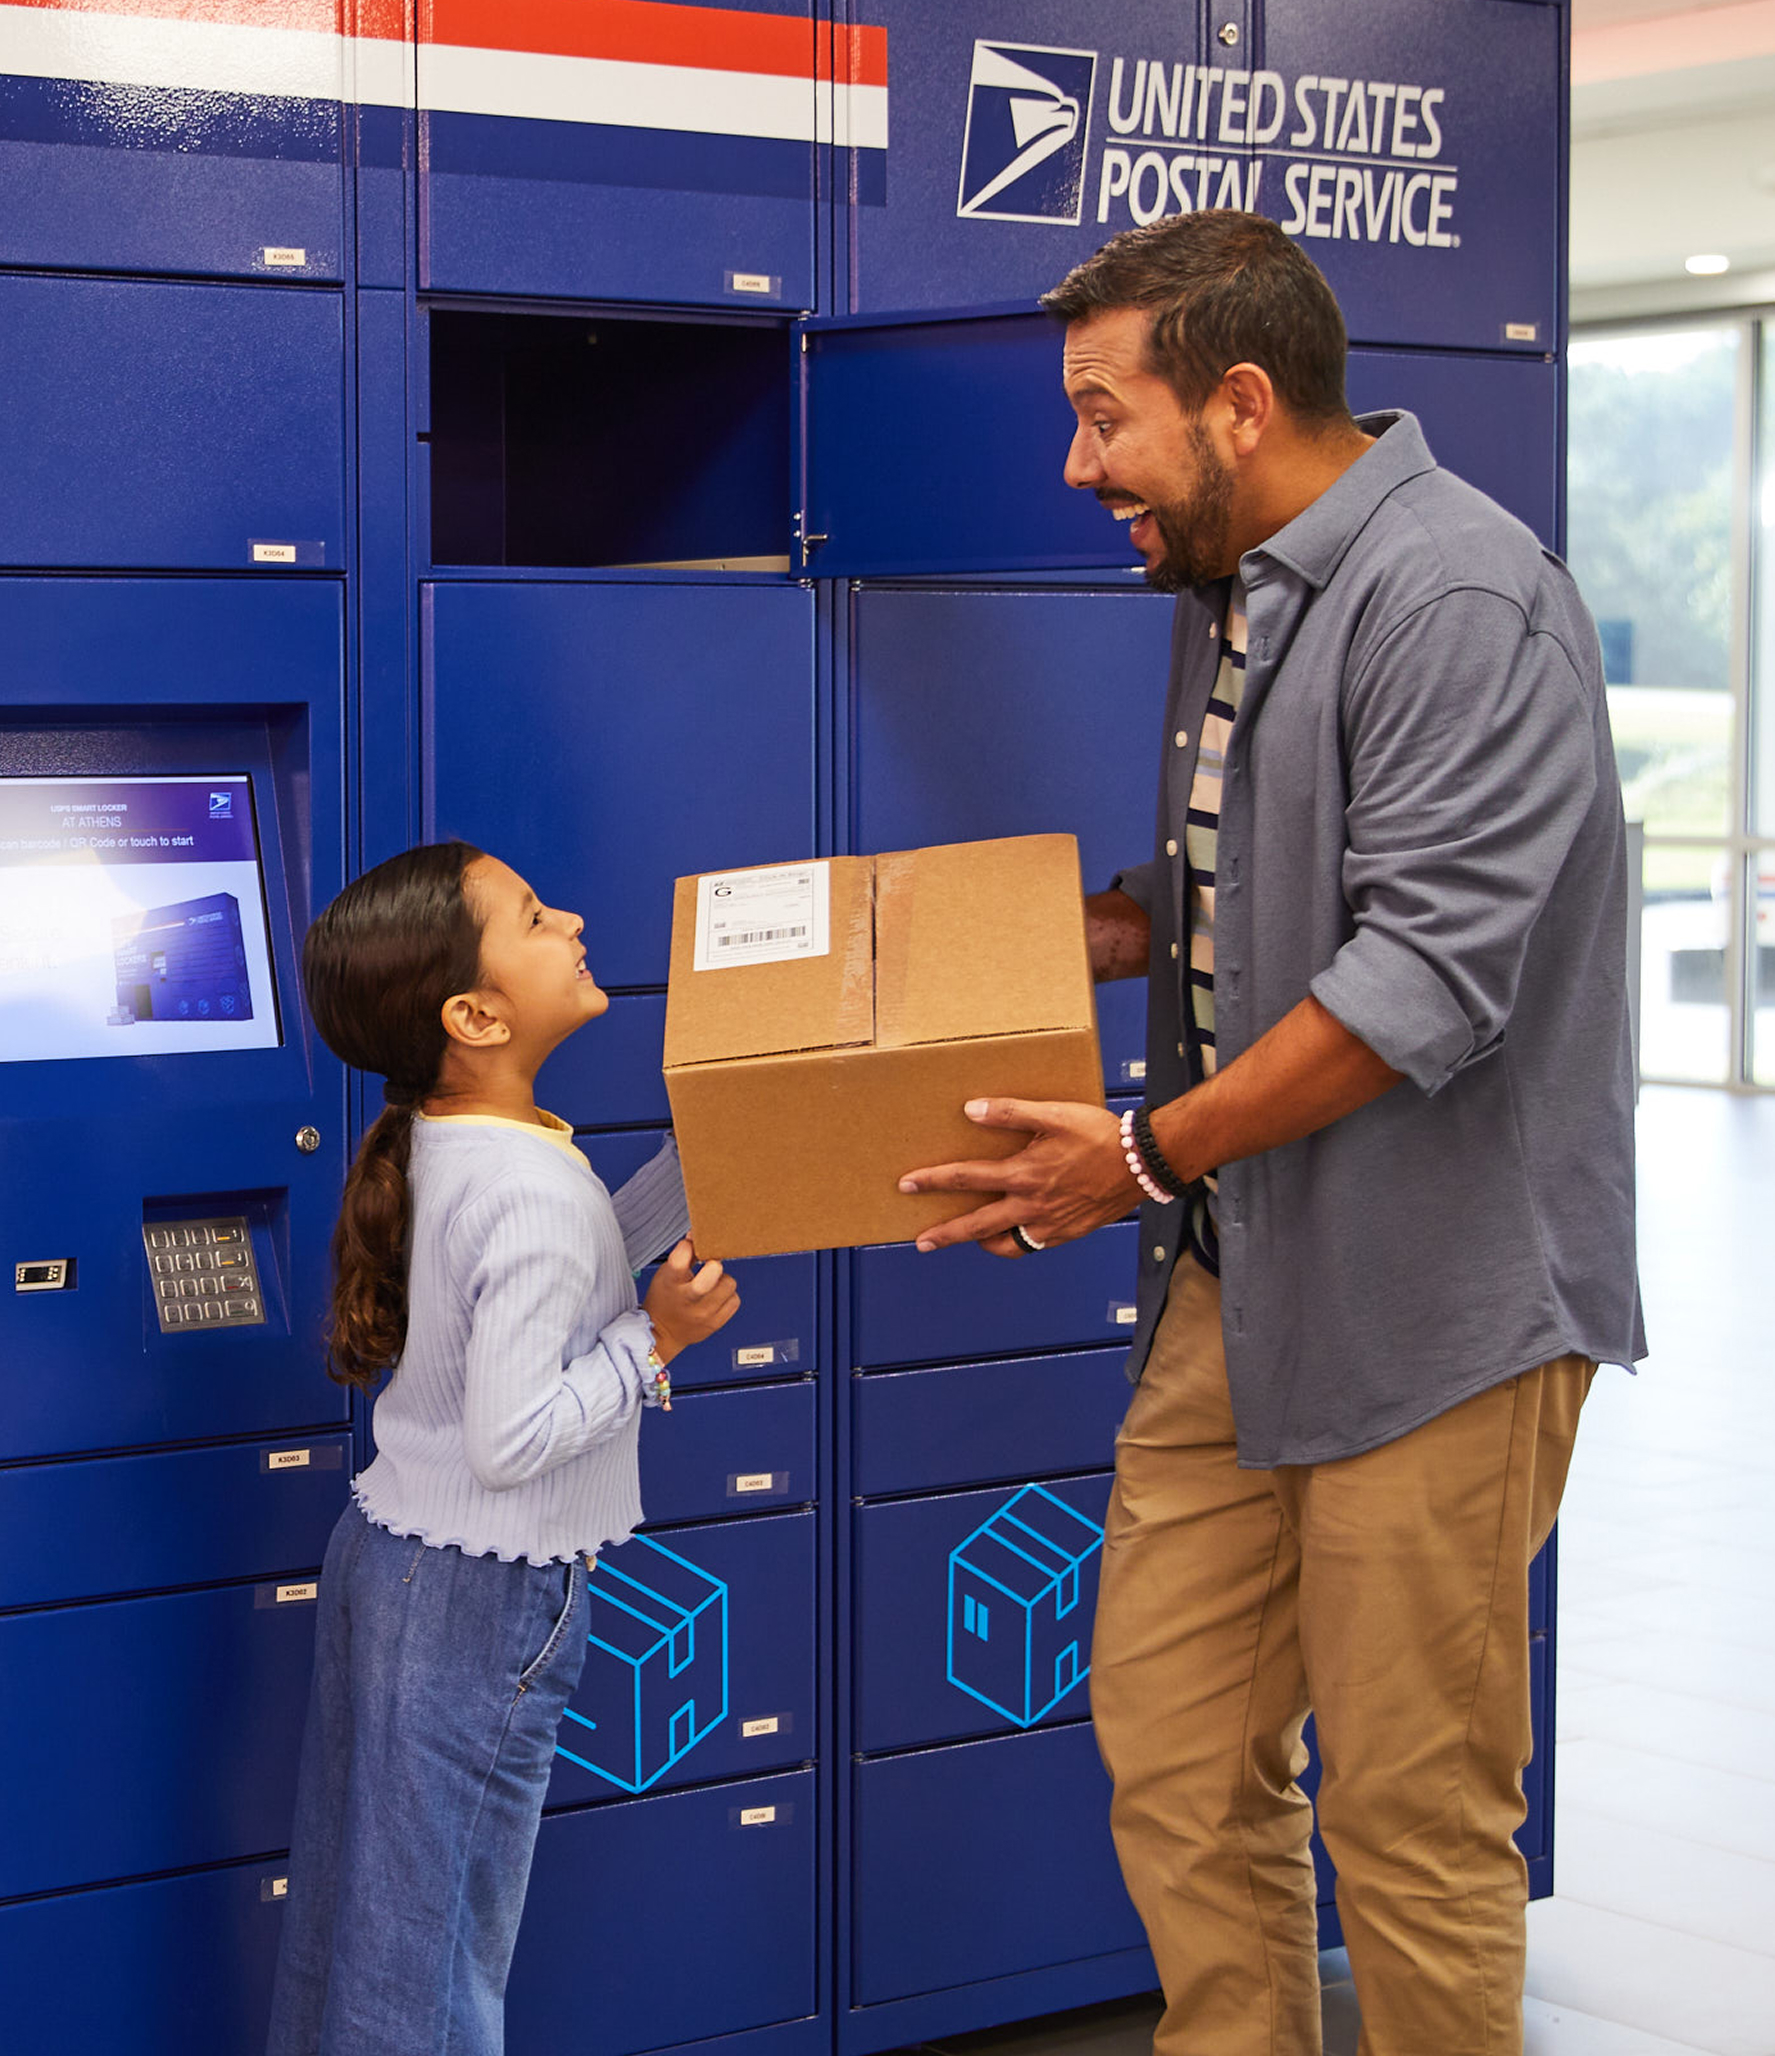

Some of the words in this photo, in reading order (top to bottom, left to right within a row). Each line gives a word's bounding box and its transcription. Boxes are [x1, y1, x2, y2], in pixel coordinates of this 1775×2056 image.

[1108, 57, 1286, 144] UNITED
[1290, 75, 1445, 159] STATES
[97, 804, 128, 812] LOCKER
[62, 816, 76, 828] AT
[79, 816, 122, 828] ATHENS
[69, 836, 87, 847] QR
[89, 836, 116, 847] Code
[117, 839, 128, 847] or
[130, 836, 158, 847] touch
[159, 835, 170, 846] to
[171, 835, 194, 846] start
[715, 886, 732, 897] G
[278, 1455, 300, 1463] K3D03
[286, 1588, 307, 1597] K3D02
